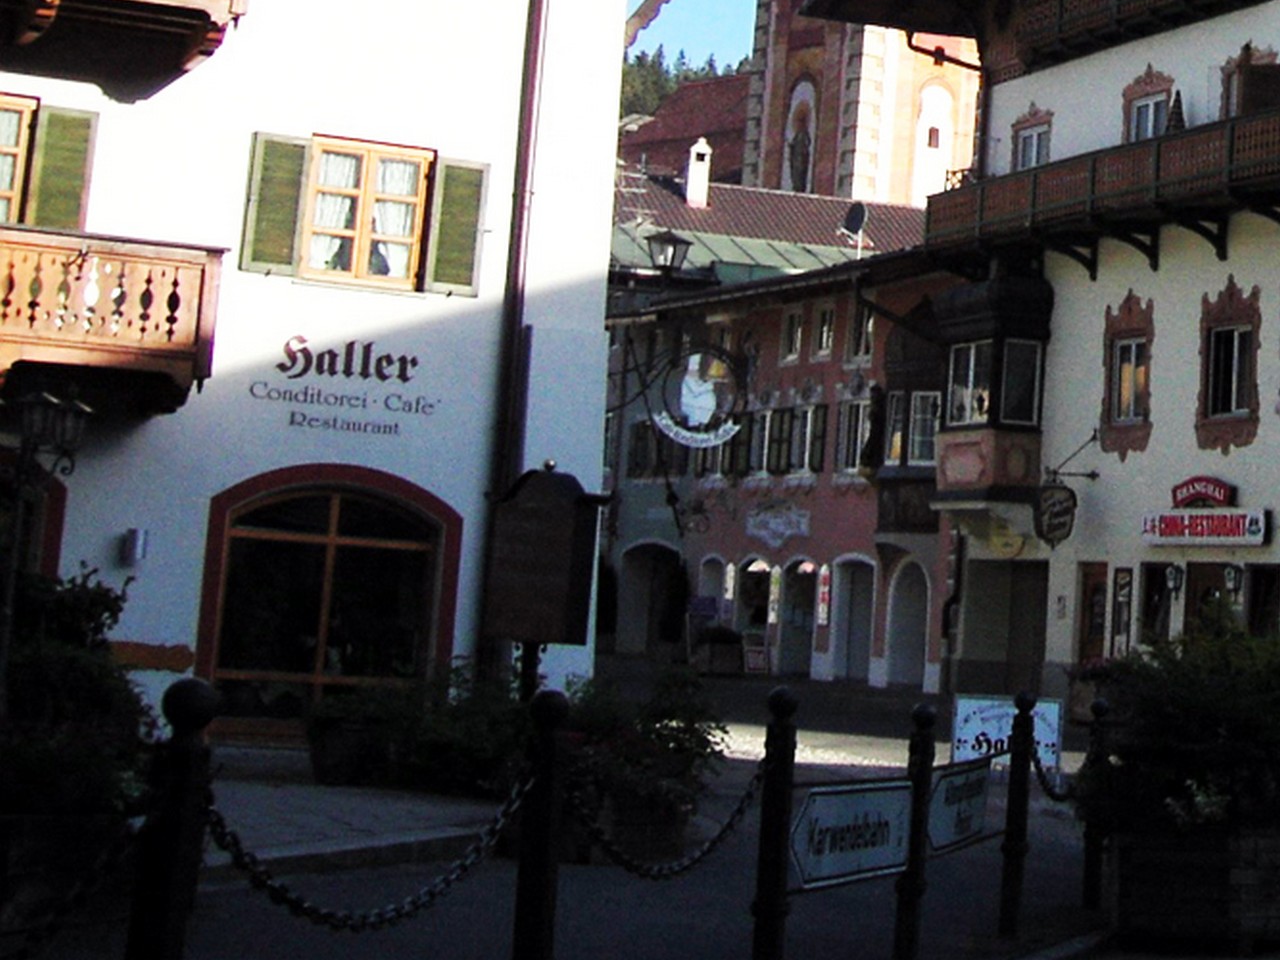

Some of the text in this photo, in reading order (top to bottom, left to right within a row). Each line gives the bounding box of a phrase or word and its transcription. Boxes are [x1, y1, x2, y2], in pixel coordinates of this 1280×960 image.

[276, 335, 418, 383] Haller
[250, 381, 368, 409] Conditorei
[289, 411, 399, 435] Restaurant
[1176, 481, 1224, 500] SHANGHAI
[808, 810, 890, 856] Karwendelbahn
